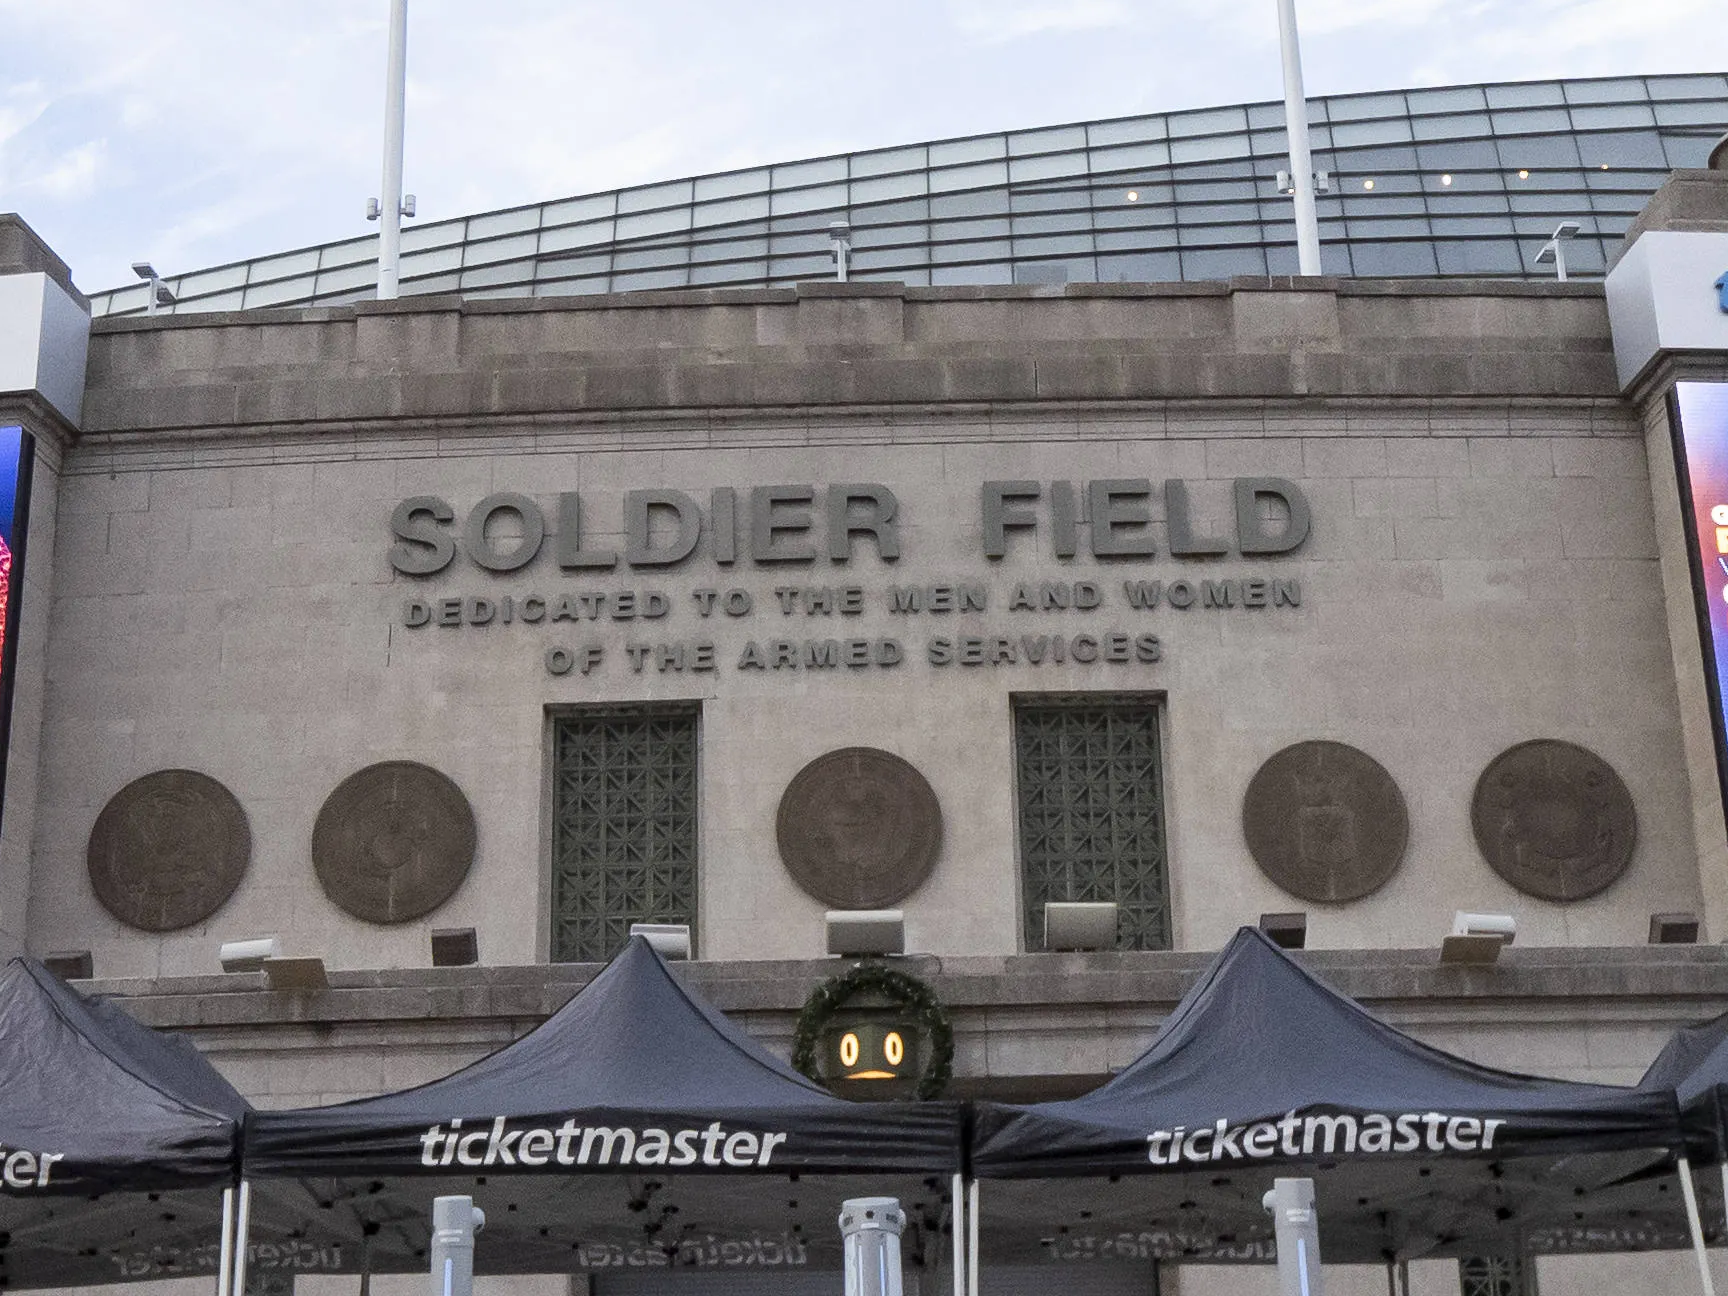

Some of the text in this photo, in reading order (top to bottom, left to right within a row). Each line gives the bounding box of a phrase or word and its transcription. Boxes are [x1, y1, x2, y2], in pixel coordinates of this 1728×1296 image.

[389, 476, 1311, 576] SOLDIER FIELD
[405, 576, 1300, 628] DEDICATED TO THE MEN AND WOMEN
[545, 631, 1162, 676] OF THE ARMED SERVICES
[421, 1116, 786, 1167] ticketmaster
[1147, 1110, 1506, 1165] ticketmaster
